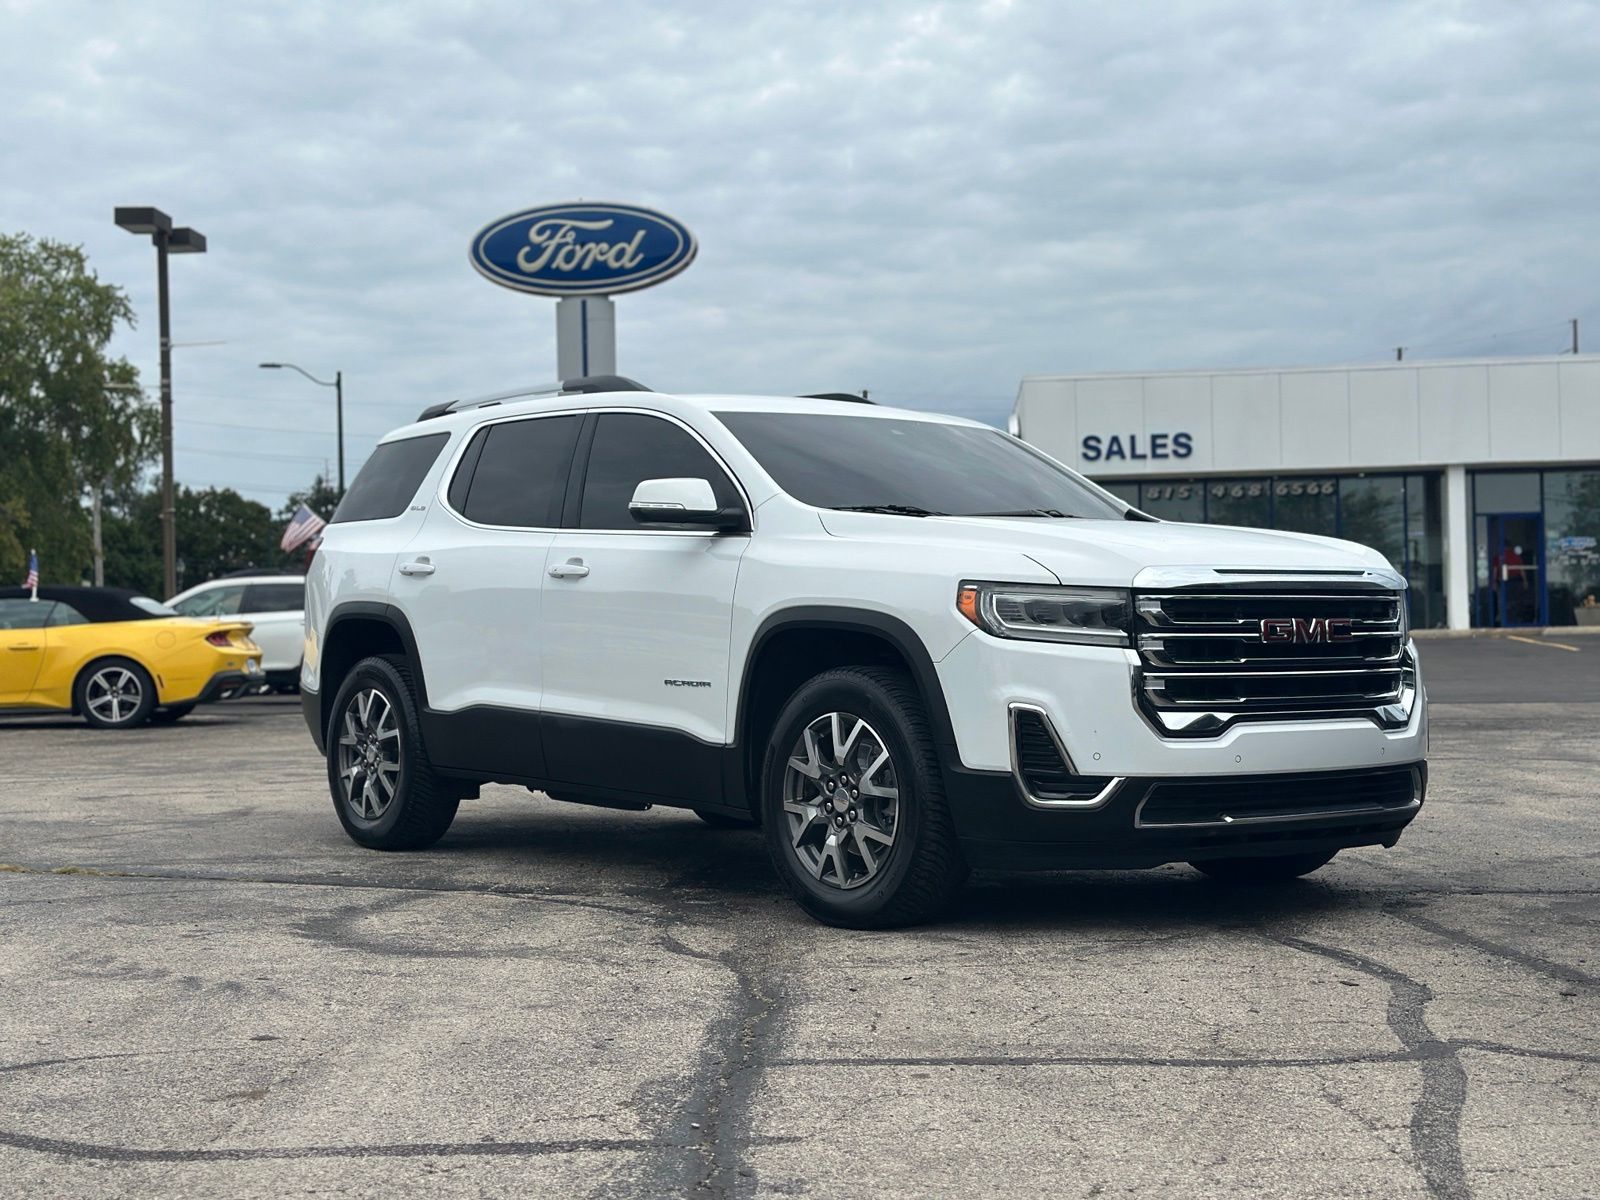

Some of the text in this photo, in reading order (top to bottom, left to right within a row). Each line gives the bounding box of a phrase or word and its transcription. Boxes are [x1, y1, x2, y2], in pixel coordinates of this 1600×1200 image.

[516, 218, 647, 273] Ford
[1081, 432, 1194, 462] SALES
[1146, 480, 1336, 500] 815 468 6566
[1260, 617, 1353, 644] GMC
[664, 679, 712, 688] ACADIA
